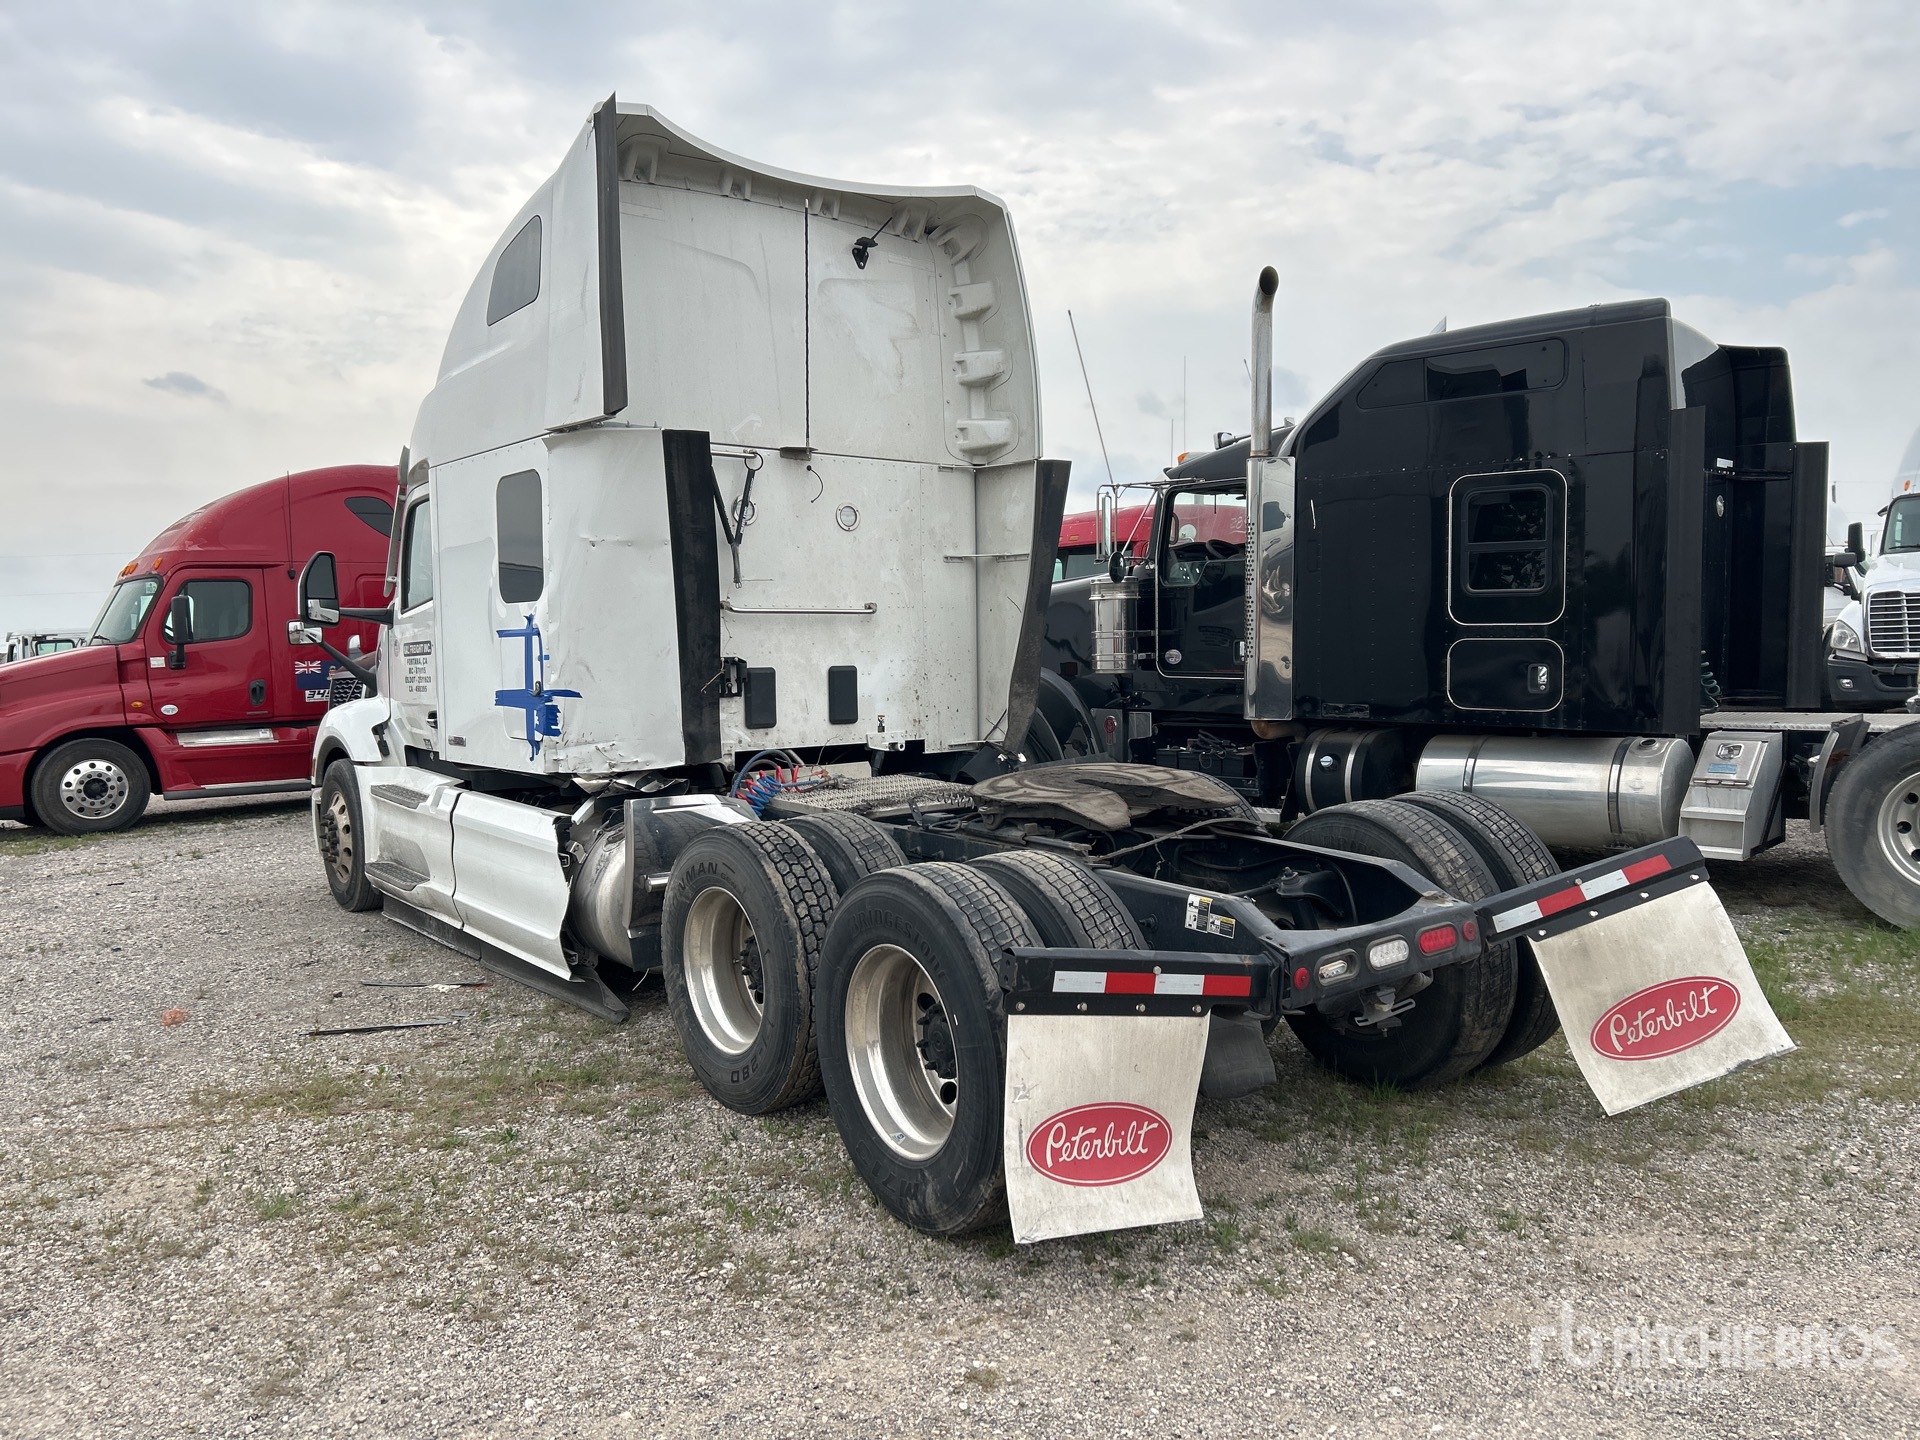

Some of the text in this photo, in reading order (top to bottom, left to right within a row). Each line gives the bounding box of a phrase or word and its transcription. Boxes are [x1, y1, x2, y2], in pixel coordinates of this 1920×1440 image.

[848, 908, 947, 981] BRIDGESTONE
[1608, 984, 1719, 1053] Peterbilt
[1044, 1120, 1159, 1168] Peterbilt
